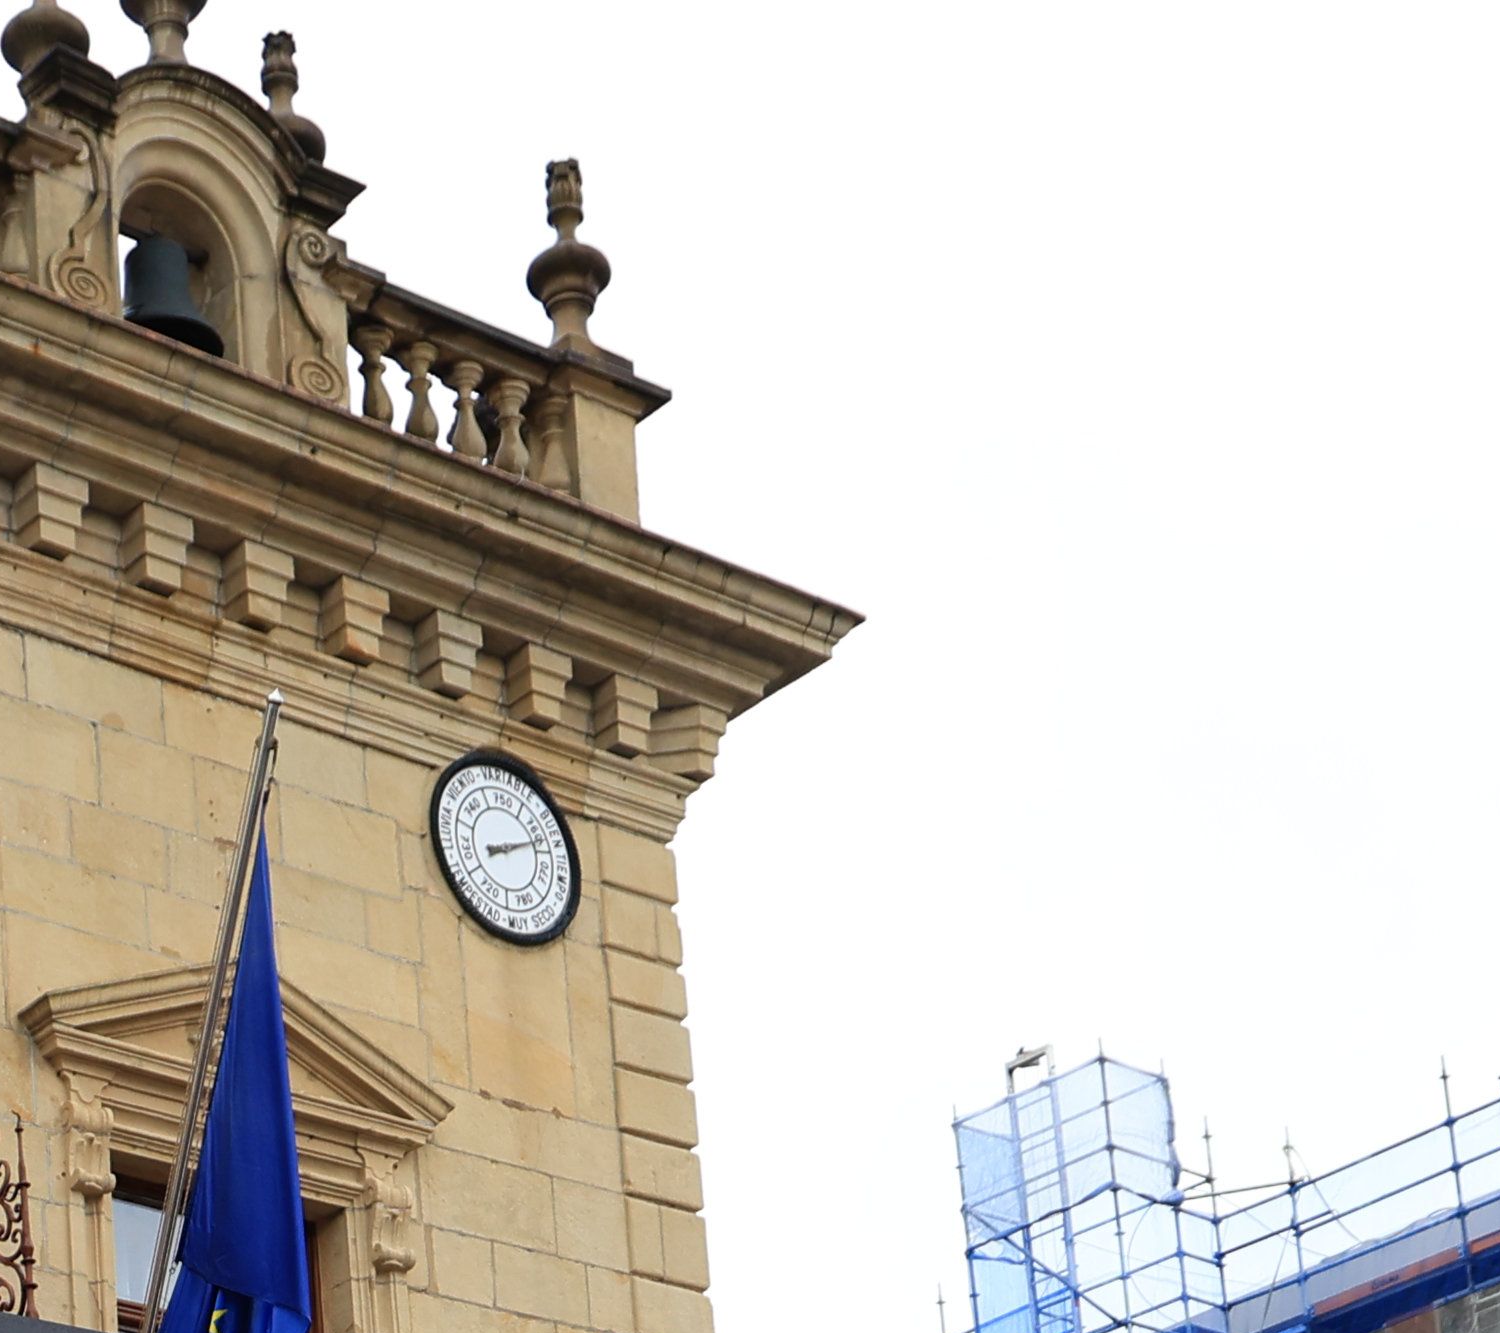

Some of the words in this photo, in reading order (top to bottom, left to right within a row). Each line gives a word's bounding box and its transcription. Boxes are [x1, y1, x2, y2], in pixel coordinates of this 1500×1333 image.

[449, 770, 476, 802] VIENTO
[480, 766, 534, 804] VARIABLE
[464, 797, 481, 817] 740
[493, 791, 513, 809] 750
[440, 808, 453, 850] LLUVIA
[460, 833, 472, 861] 730
[539, 810, 564, 850] BUEN
[555, 853, 569, 902] TIEMPO
[538, 861, 549, 884] 770
[448, 859, 501, 923] TEMPESTAD
[481, 875, 499, 898] 720
[515, 892, 533, 907] 780
[508, 916, 530, 931] MUY
[534, 906, 556, 929] SECO
